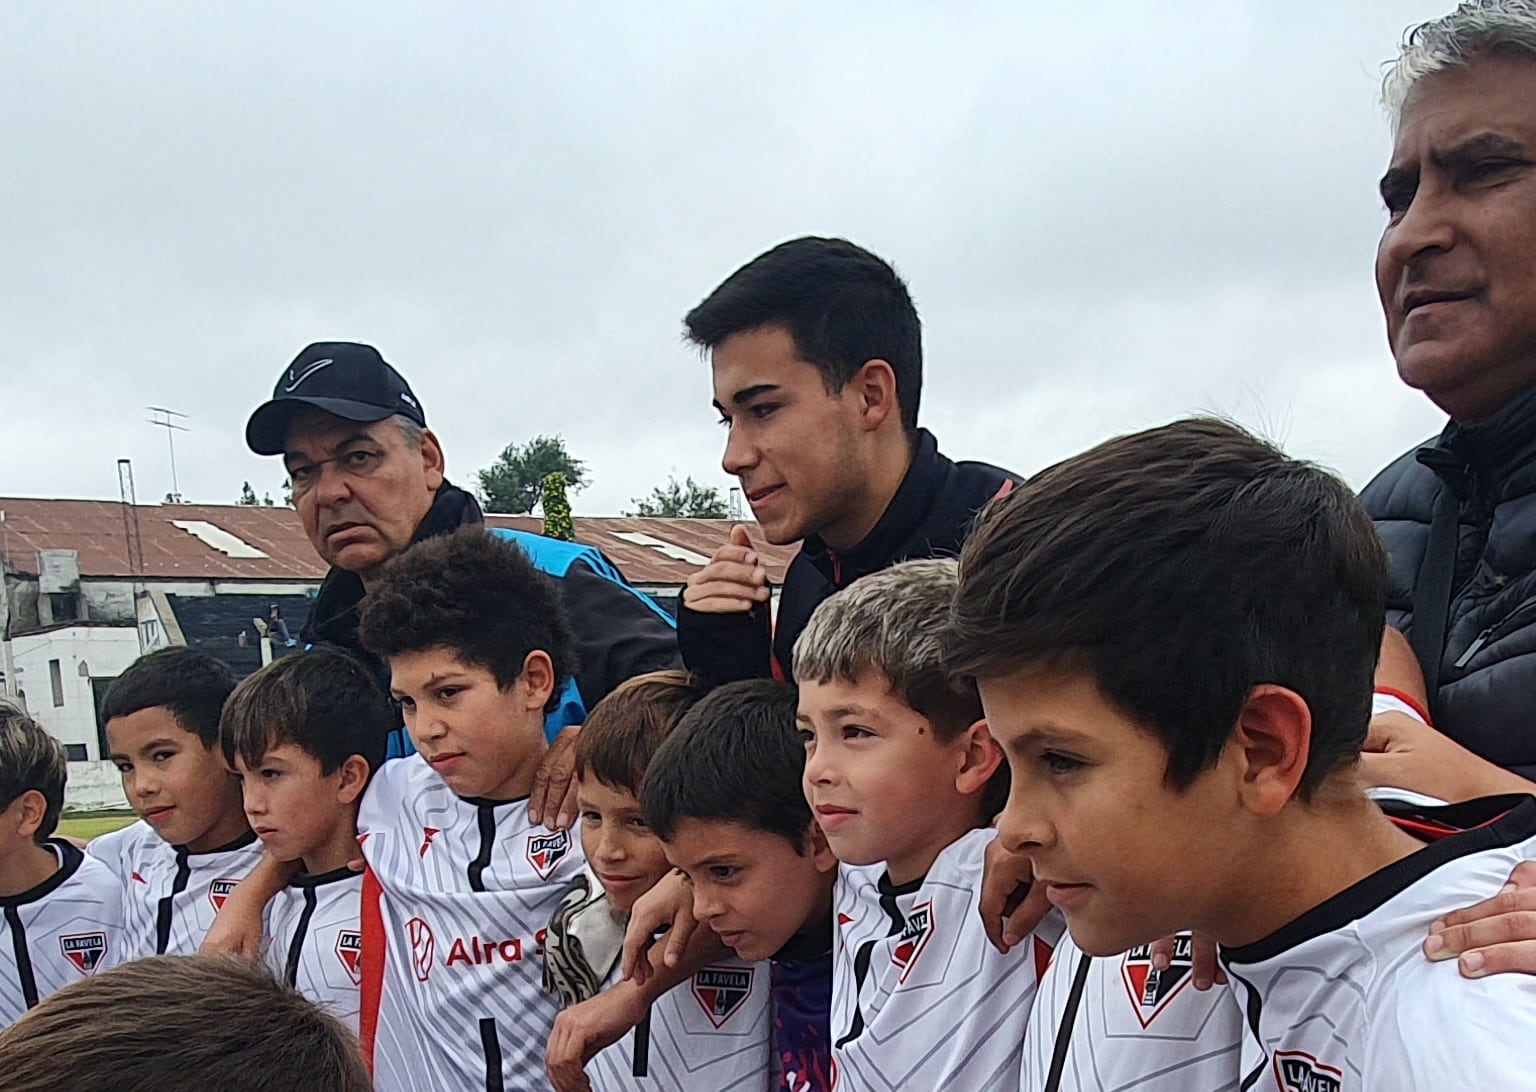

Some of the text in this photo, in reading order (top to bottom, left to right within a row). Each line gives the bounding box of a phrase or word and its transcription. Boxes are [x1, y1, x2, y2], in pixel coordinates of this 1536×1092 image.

[446, 936, 522, 966] Alra
[698, 972, 746, 986] LA FAVELA
